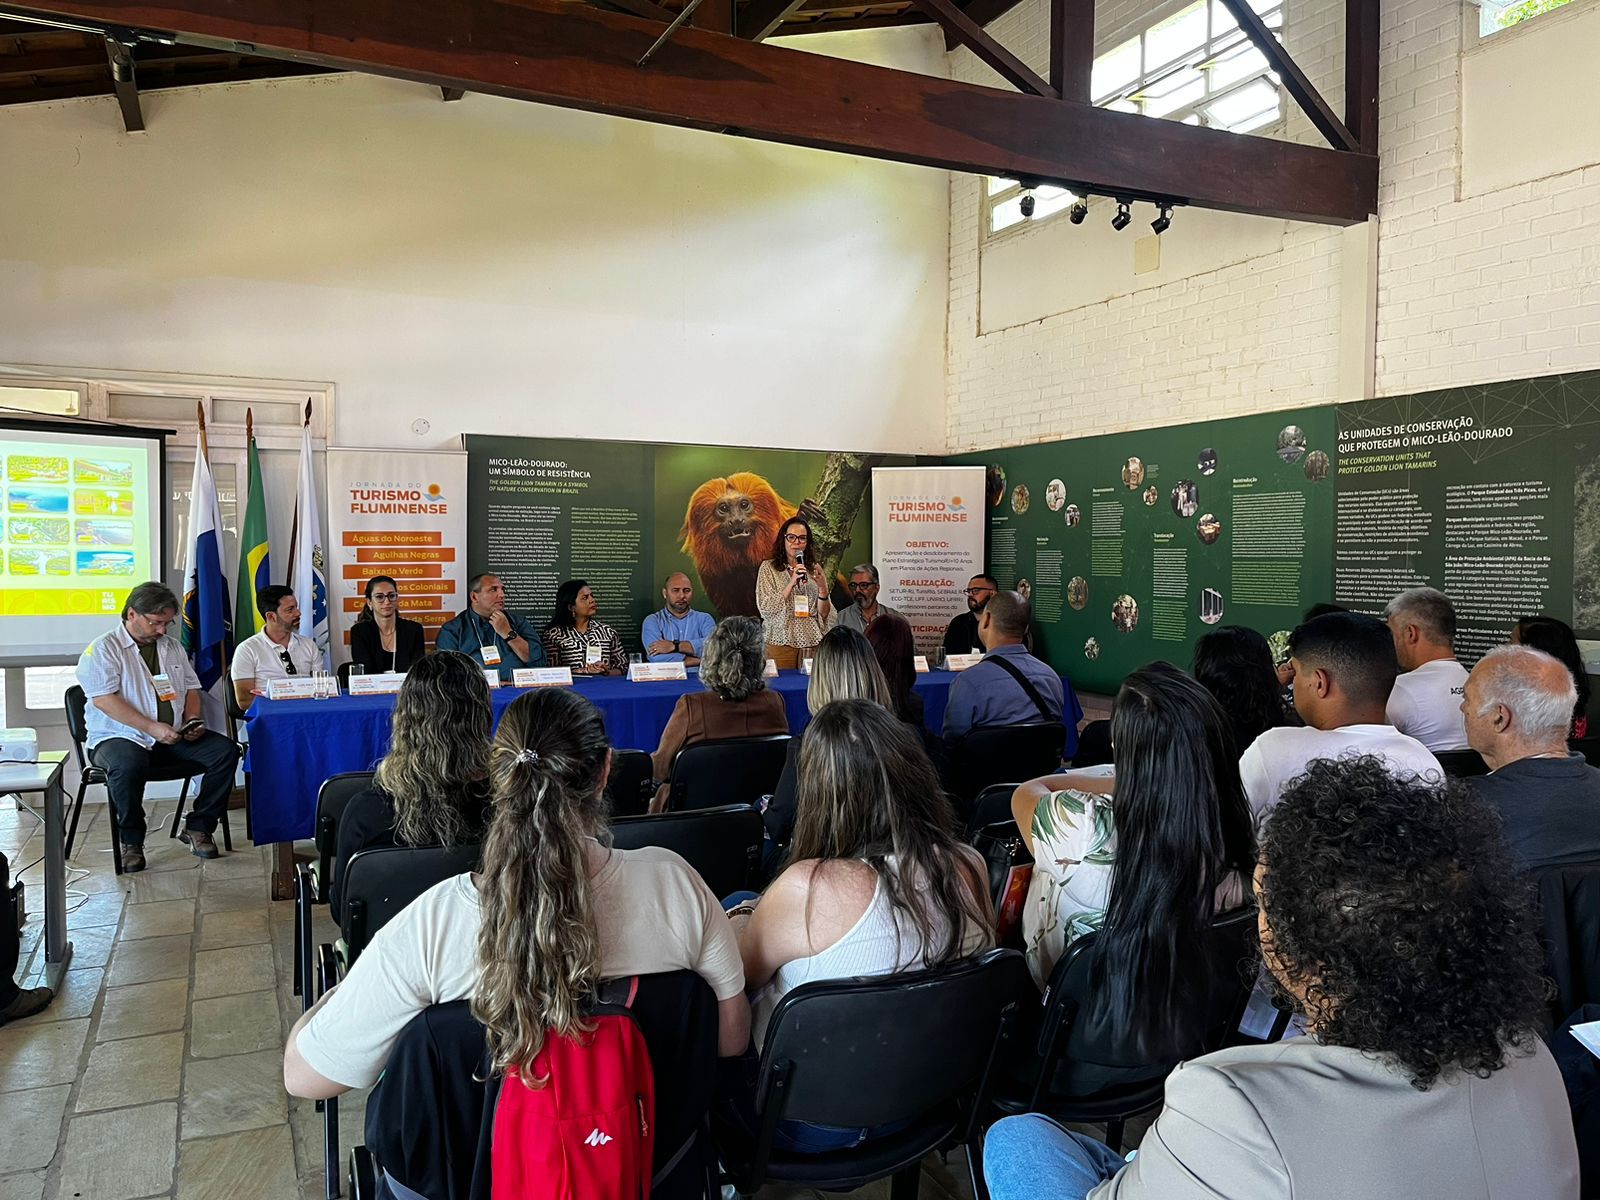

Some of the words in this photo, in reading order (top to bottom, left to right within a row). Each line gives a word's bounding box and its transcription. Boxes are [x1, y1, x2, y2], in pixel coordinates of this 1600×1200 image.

[1338, 431, 1349, 440] AS
[1350, 426, 1392, 439] UNIDADES
[1394, 424, 1405, 434] DE
[1407, 416, 1473, 433] CONSERVAÇÃO
[1338, 442, 1355, 454] QUE
[1356, 439, 1400, 451] PROTEGEM
[1402, 438, 1410, 446] O
[1412, 427, 1513, 446] MICO-LEÃO-DOURADO
[488, 458, 568, 468] MICO-LEÃO-DOURADO:
[1350, 454, 1394, 464] CONSERVATION
[1396, 452, 1414, 460] UNITS
[502, 466, 536, 476] SÍMBOLO
[548, 470, 591, 478] RESISTÊNCIA
[1338, 466, 1362, 474] PROTECT
[1364, 464, 1388, 472] GOLDEN
[1405, 460, 1437, 470] TAMARINS
[350, 490, 421, 500] TURISMO
[350, 503, 448, 514] FLUMINENSE
[888, 502, 946, 511] TURISMO
[888, 514, 967, 522] FLUMINENSE
[352, 534, 380, 543] Águas
[374, 552, 408, 560] Agulhas
[410, 551, 440, 560] Negras
[410, 583, 449, 591] Coloniais
[900, 579, 955, 588] REALIZAÇÃO:
[424, 615, 446, 623] Serra
